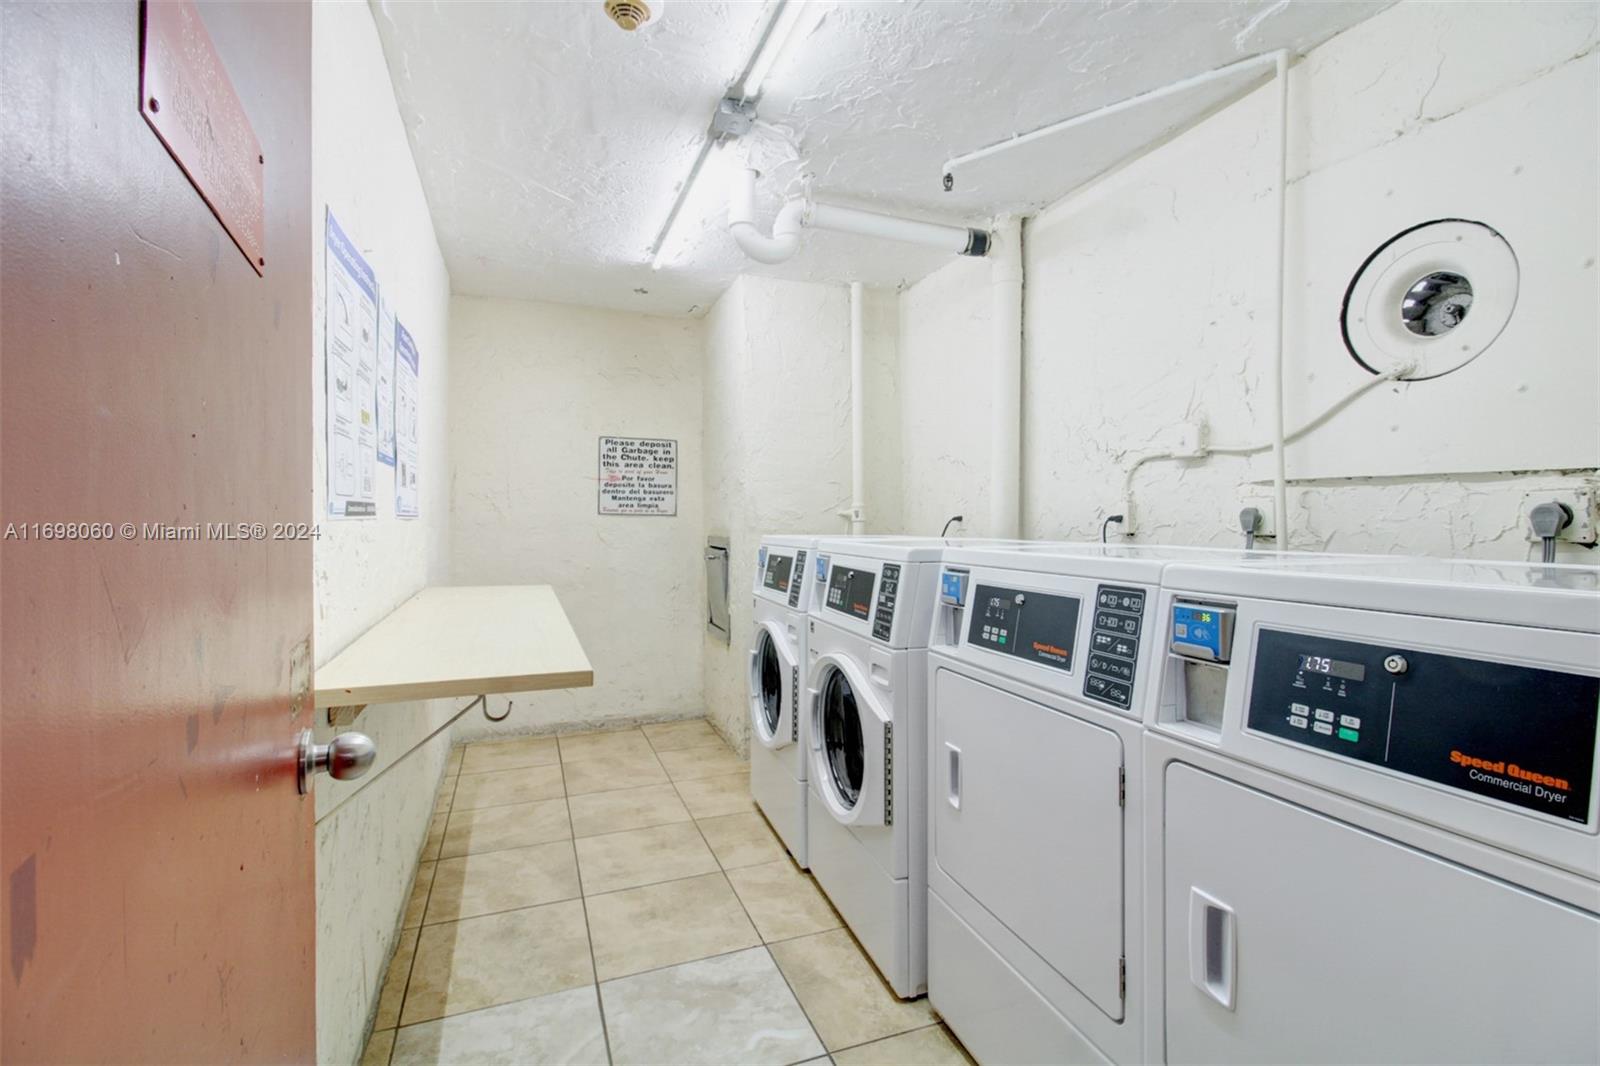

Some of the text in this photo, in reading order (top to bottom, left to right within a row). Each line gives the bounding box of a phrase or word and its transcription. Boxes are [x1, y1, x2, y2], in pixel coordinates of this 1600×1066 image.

[622, 447, 658, 455] Garbage
[1450, 750, 1570, 790] Speed Queen
[1468, 768, 1568, 804] Commercial Dryer
